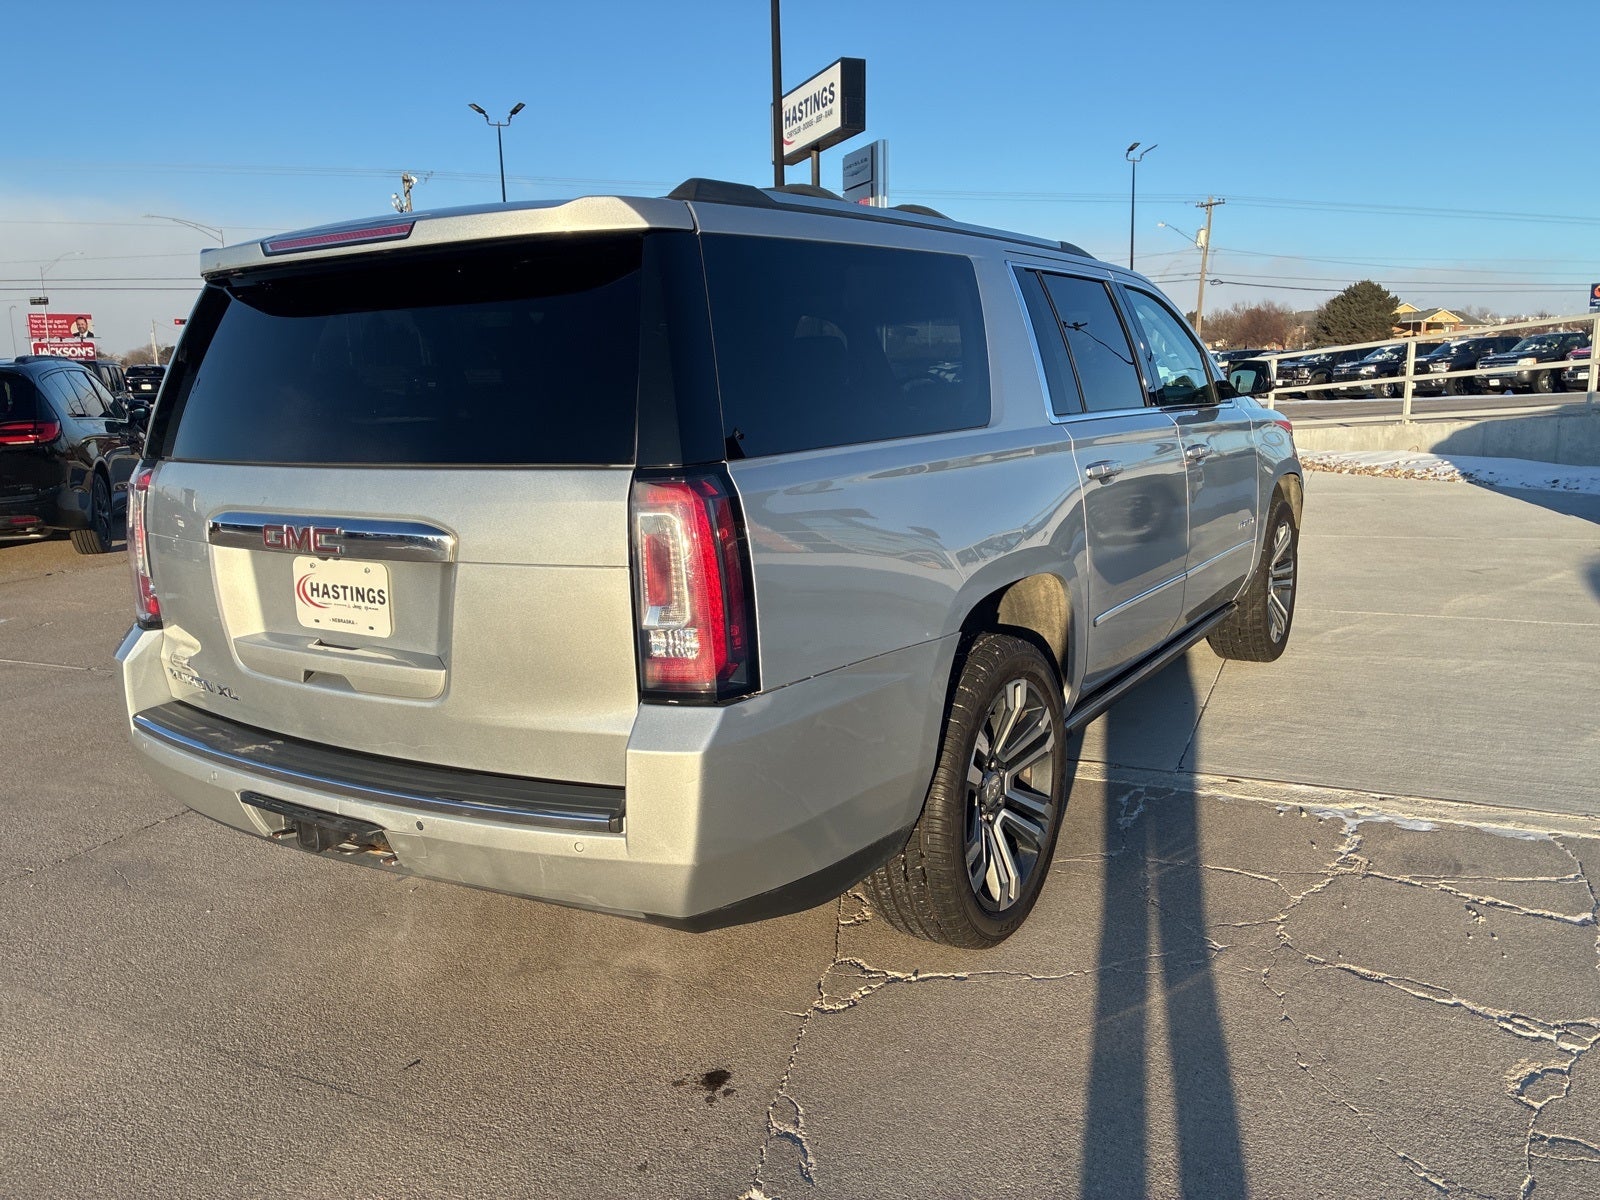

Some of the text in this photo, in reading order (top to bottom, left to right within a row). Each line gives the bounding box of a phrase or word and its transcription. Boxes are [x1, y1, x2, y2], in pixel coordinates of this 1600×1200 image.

[784, 82, 835, 130] HASTINGS
[36, 347, 94, 357] JACKSON'S
[262, 524, 344, 554] GMC
[310, 582, 386, 605] HASTINGS
[331, 617, 355, 625] NEBRASKA
[217, 684, 241, 702] XL
